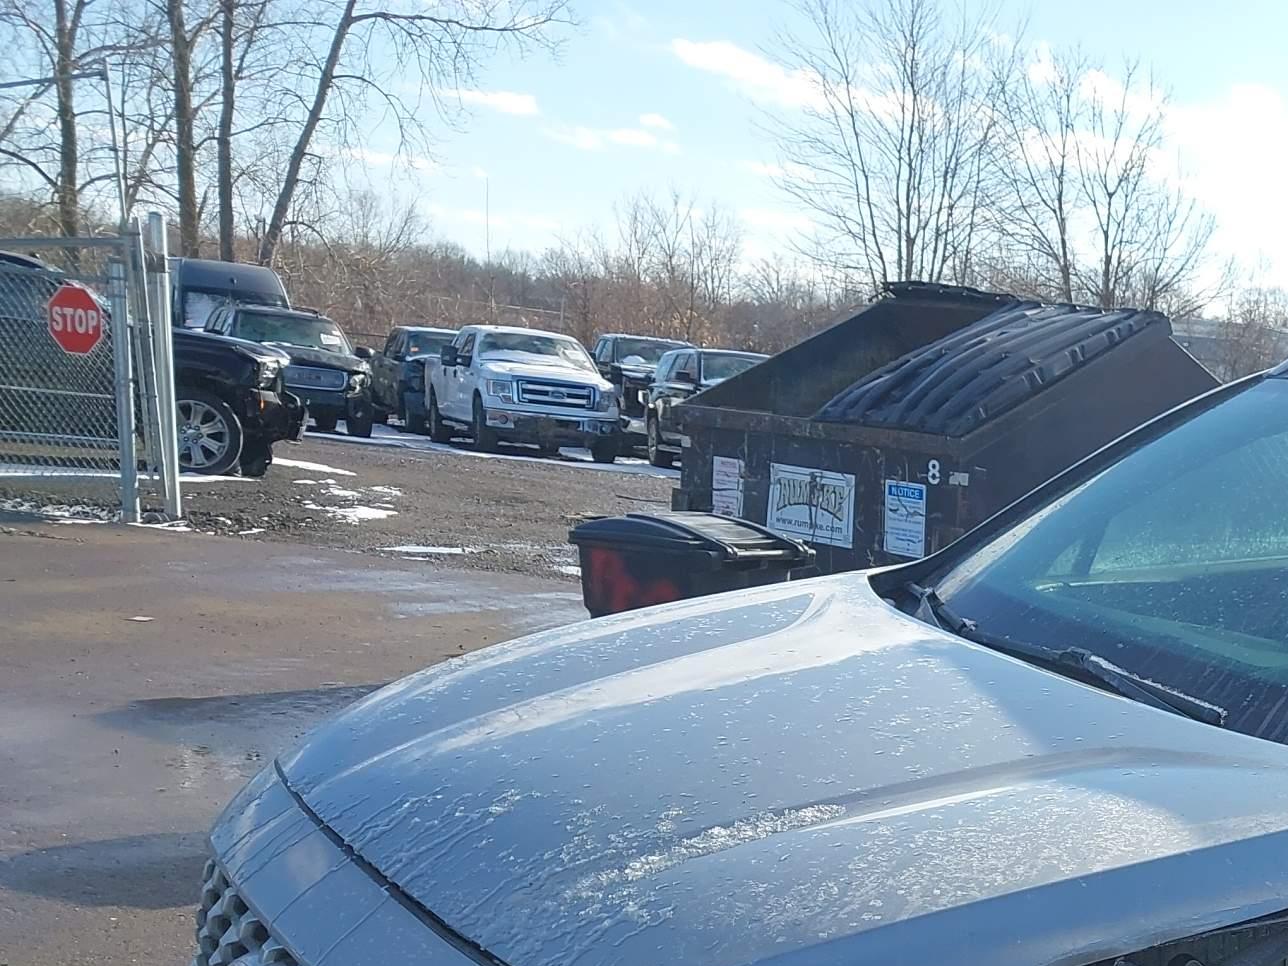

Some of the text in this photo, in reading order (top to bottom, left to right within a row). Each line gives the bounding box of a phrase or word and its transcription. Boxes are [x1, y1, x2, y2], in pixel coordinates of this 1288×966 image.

[51, 306, 97, 334] STOP
[927, 459, 941, 485] 8
[890, 486, 921, 499] NOTICE
